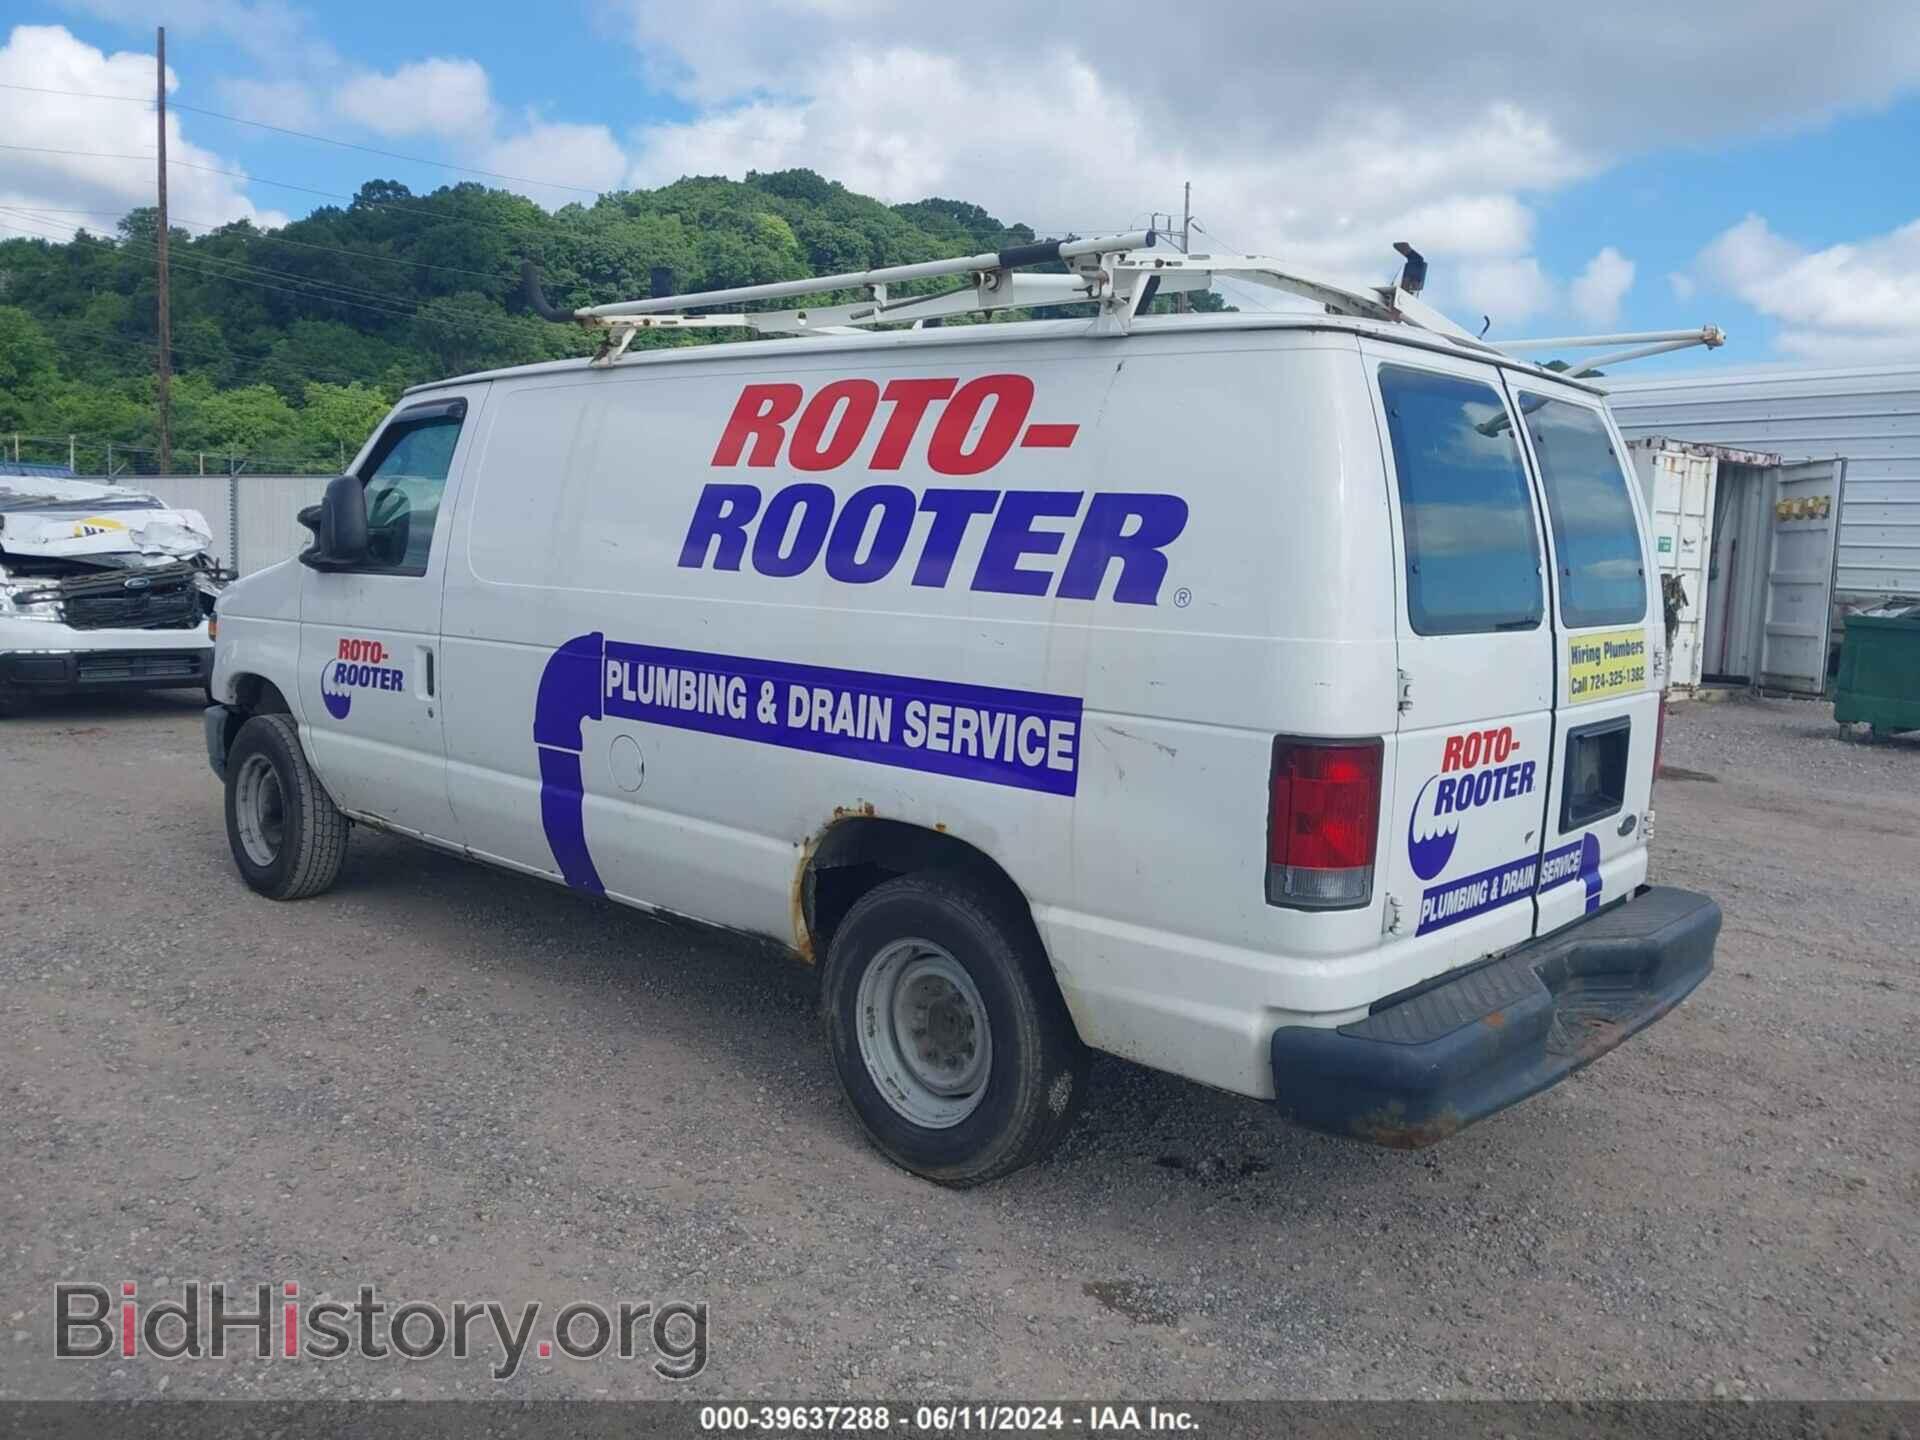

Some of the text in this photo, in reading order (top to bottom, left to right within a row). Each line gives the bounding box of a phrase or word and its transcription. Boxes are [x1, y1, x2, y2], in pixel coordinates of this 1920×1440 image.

[710, 373, 1081, 476] ROTO-
[677, 482, 1190, 606] ROOTER
[338, 638, 389, 664] ROTO-
[1571, 639, 1644, 666] Hiring Plumbers
[333, 662, 404, 692] ROOTER
[1571, 676, 1588, 694] Call
[606, 659, 1077, 772] PLUMBING & DRAIN SERVICE
[1441, 726, 1521, 773] ROTO-
[1433, 760, 1536, 816] ROOTER
[1420, 850, 1582, 926] PLUMBING & DRAIN SERVICE
